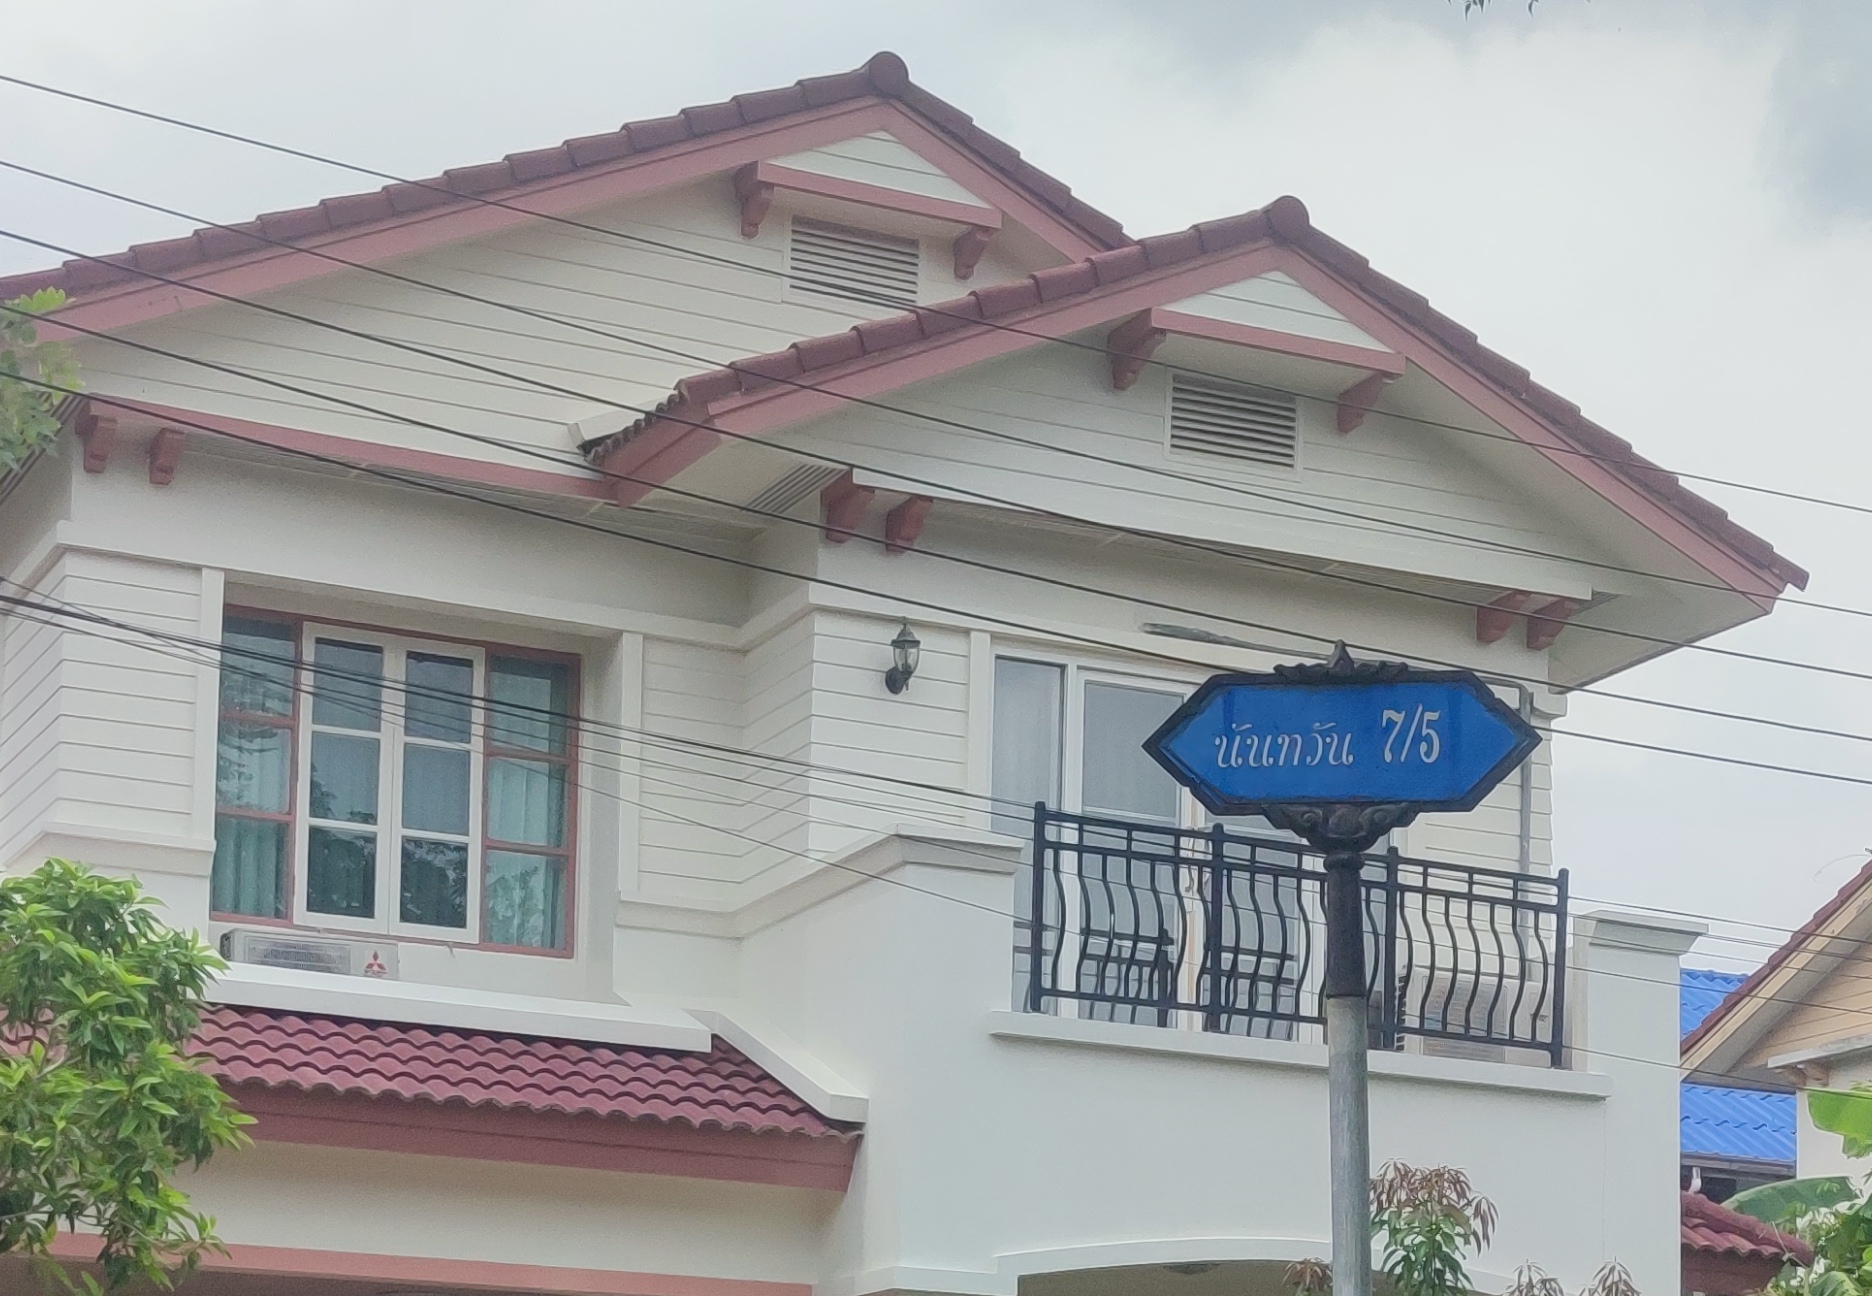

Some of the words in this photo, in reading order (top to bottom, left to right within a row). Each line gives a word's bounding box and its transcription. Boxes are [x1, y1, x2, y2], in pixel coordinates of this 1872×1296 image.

[1214, 722, 1354, 768] นันทวัน
[1381, 703, 1441, 763] 7/5
